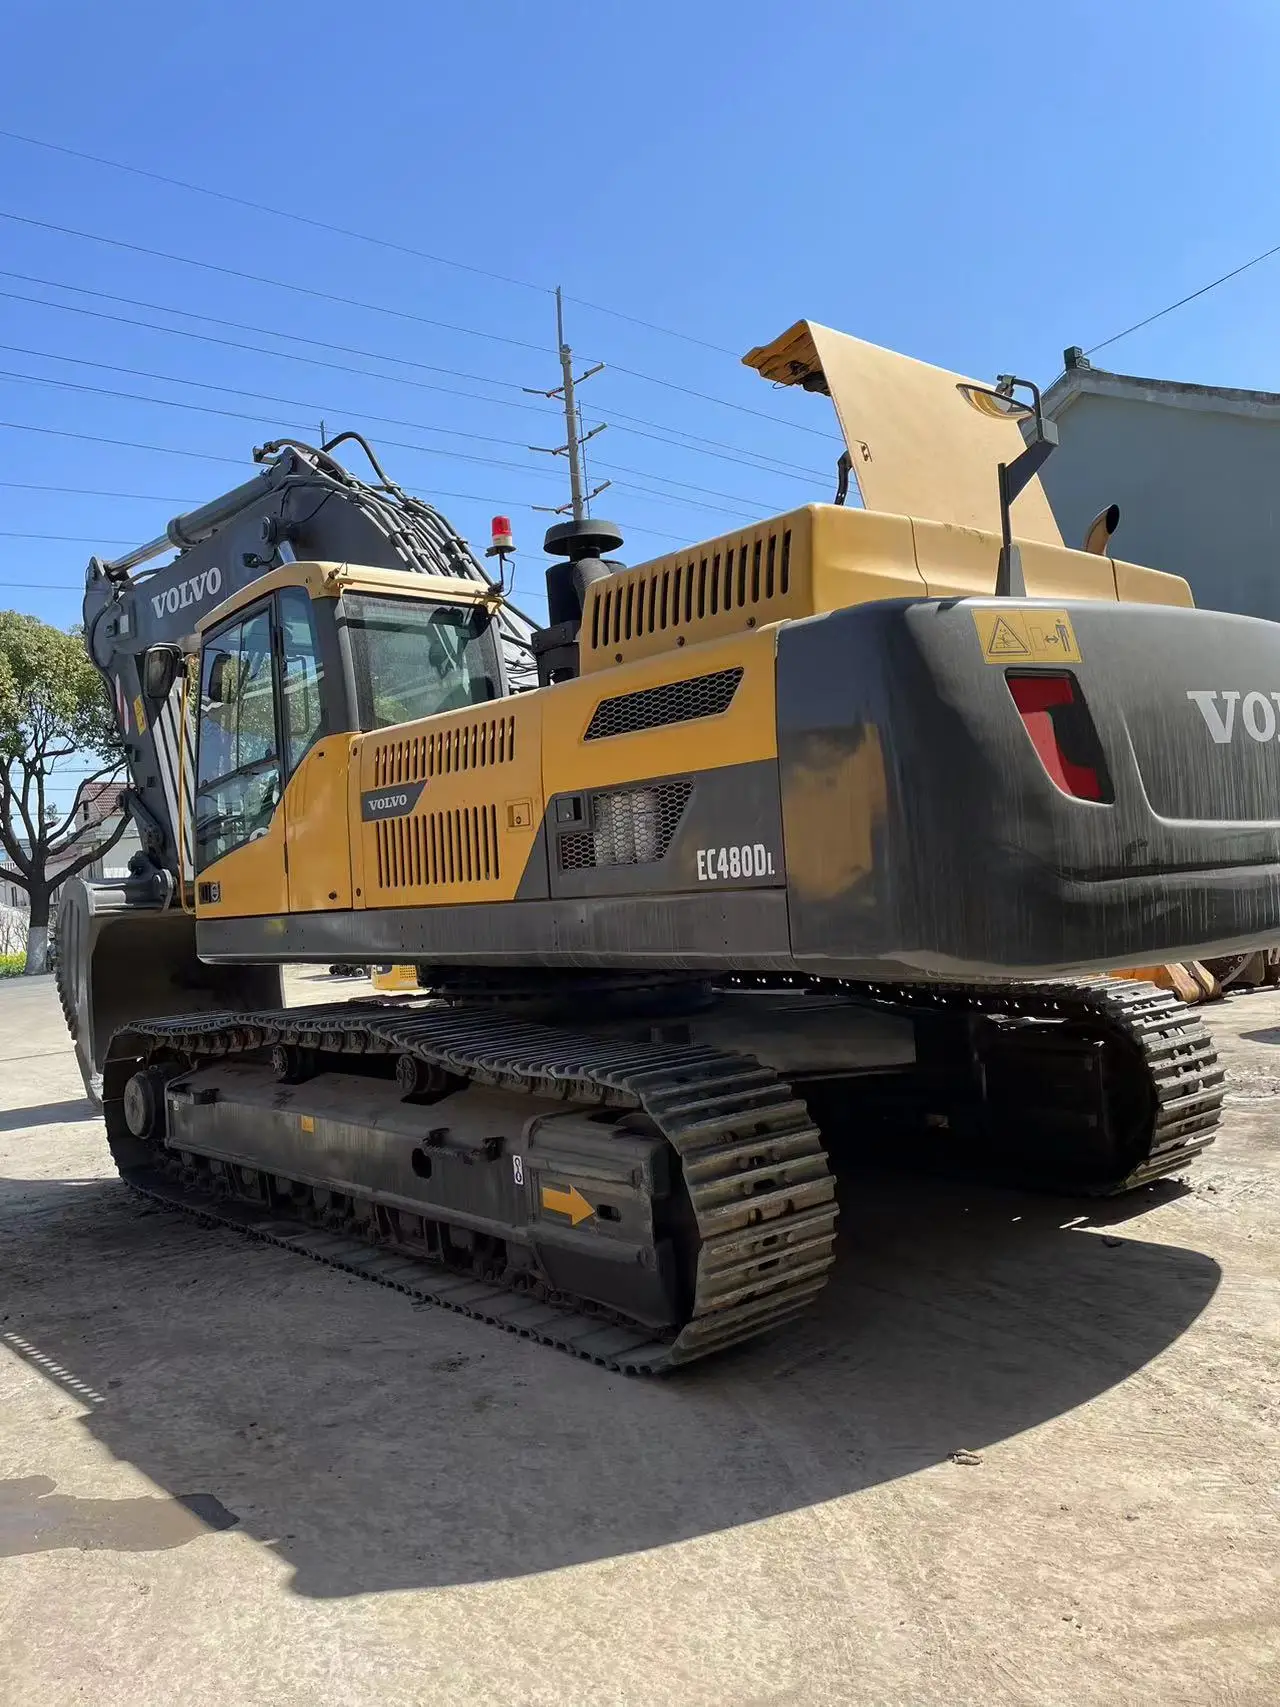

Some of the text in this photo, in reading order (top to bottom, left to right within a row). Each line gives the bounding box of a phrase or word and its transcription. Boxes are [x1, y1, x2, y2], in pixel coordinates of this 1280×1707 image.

[151, 567, 222, 619] VOLVO
[1186, 690, 1280, 744] VO
[368, 794, 408, 811] VOLVO
